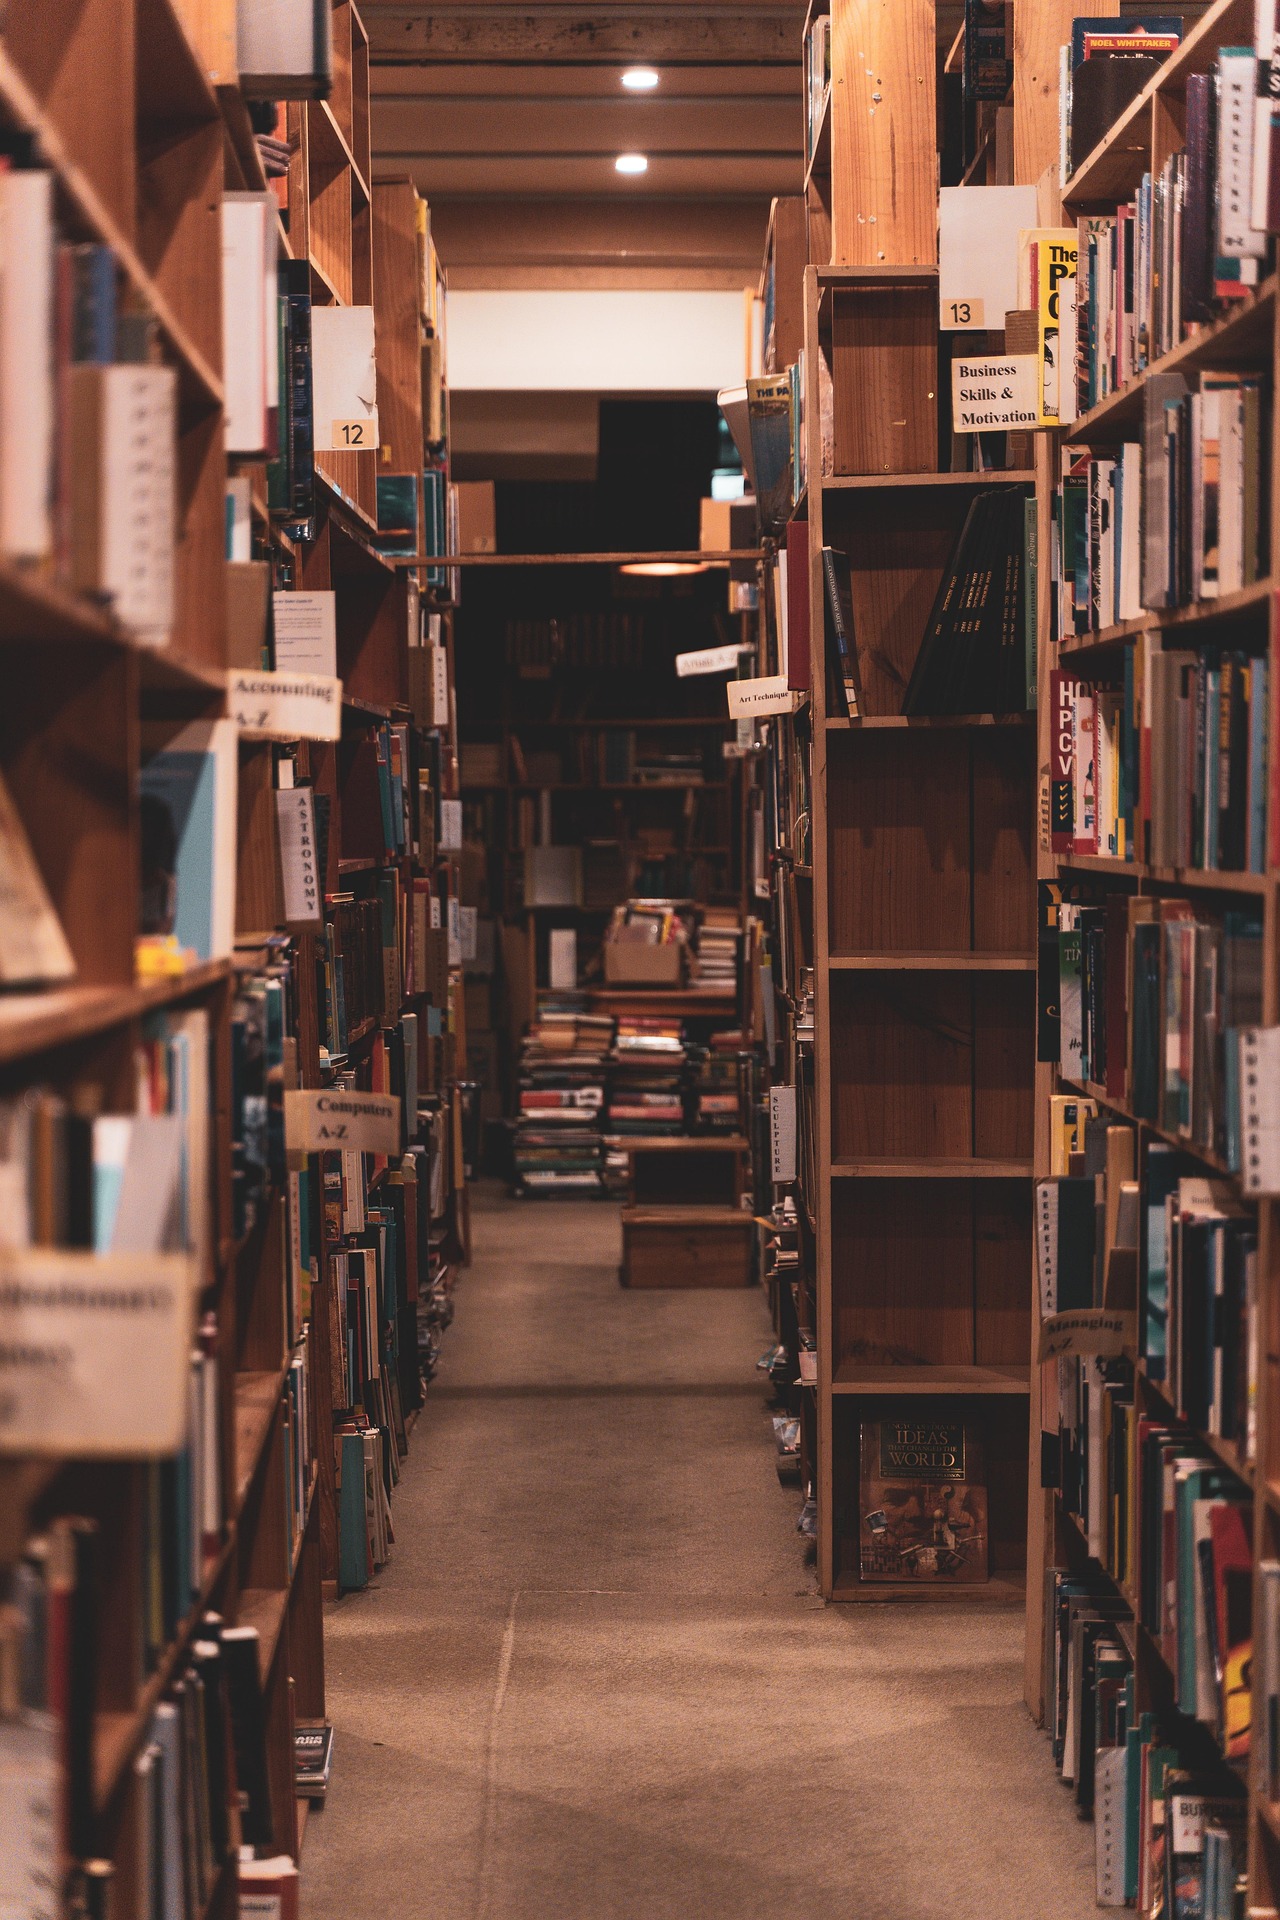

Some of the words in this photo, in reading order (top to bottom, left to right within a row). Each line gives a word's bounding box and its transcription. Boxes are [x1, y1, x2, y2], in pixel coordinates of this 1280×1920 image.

[1230, 82, 1243, 214] MARKETING
[1049, 246, 1078, 262] The
[950, 303, 971, 323] 13
[959, 364, 1017, 378] Business
[756, 388, 774, 398] THE
[776, 386, 790, 396] PA
[960, 388, 997, 402] Skills
[1000, 386, 1014, 399] &
[961, 410, 1037, 426] Motivation
[342, 424, 364, 445] 12
[234, 680, 334, 702] Accounting
[739, 696, 751, 704] Art
[752, 691, 789, 702] Technique
[298, 796, 316, 912] ASTRONOMY
[316, 1098, 394, 1118] Computers
[318, 1125, 348, 1141] A-Z
[772, 1096, 781, 1173] SCULPTURE
[1042, 1190, 1053, 1308] SECRETARIAL
[1047, 1319, 1123, 1335] Managing
[896, 1430, 949, 1445] IDEAS
[889, 1452, 956, 1467] WORLD
[1103, 1768, 1112, 1896] INVESTING
